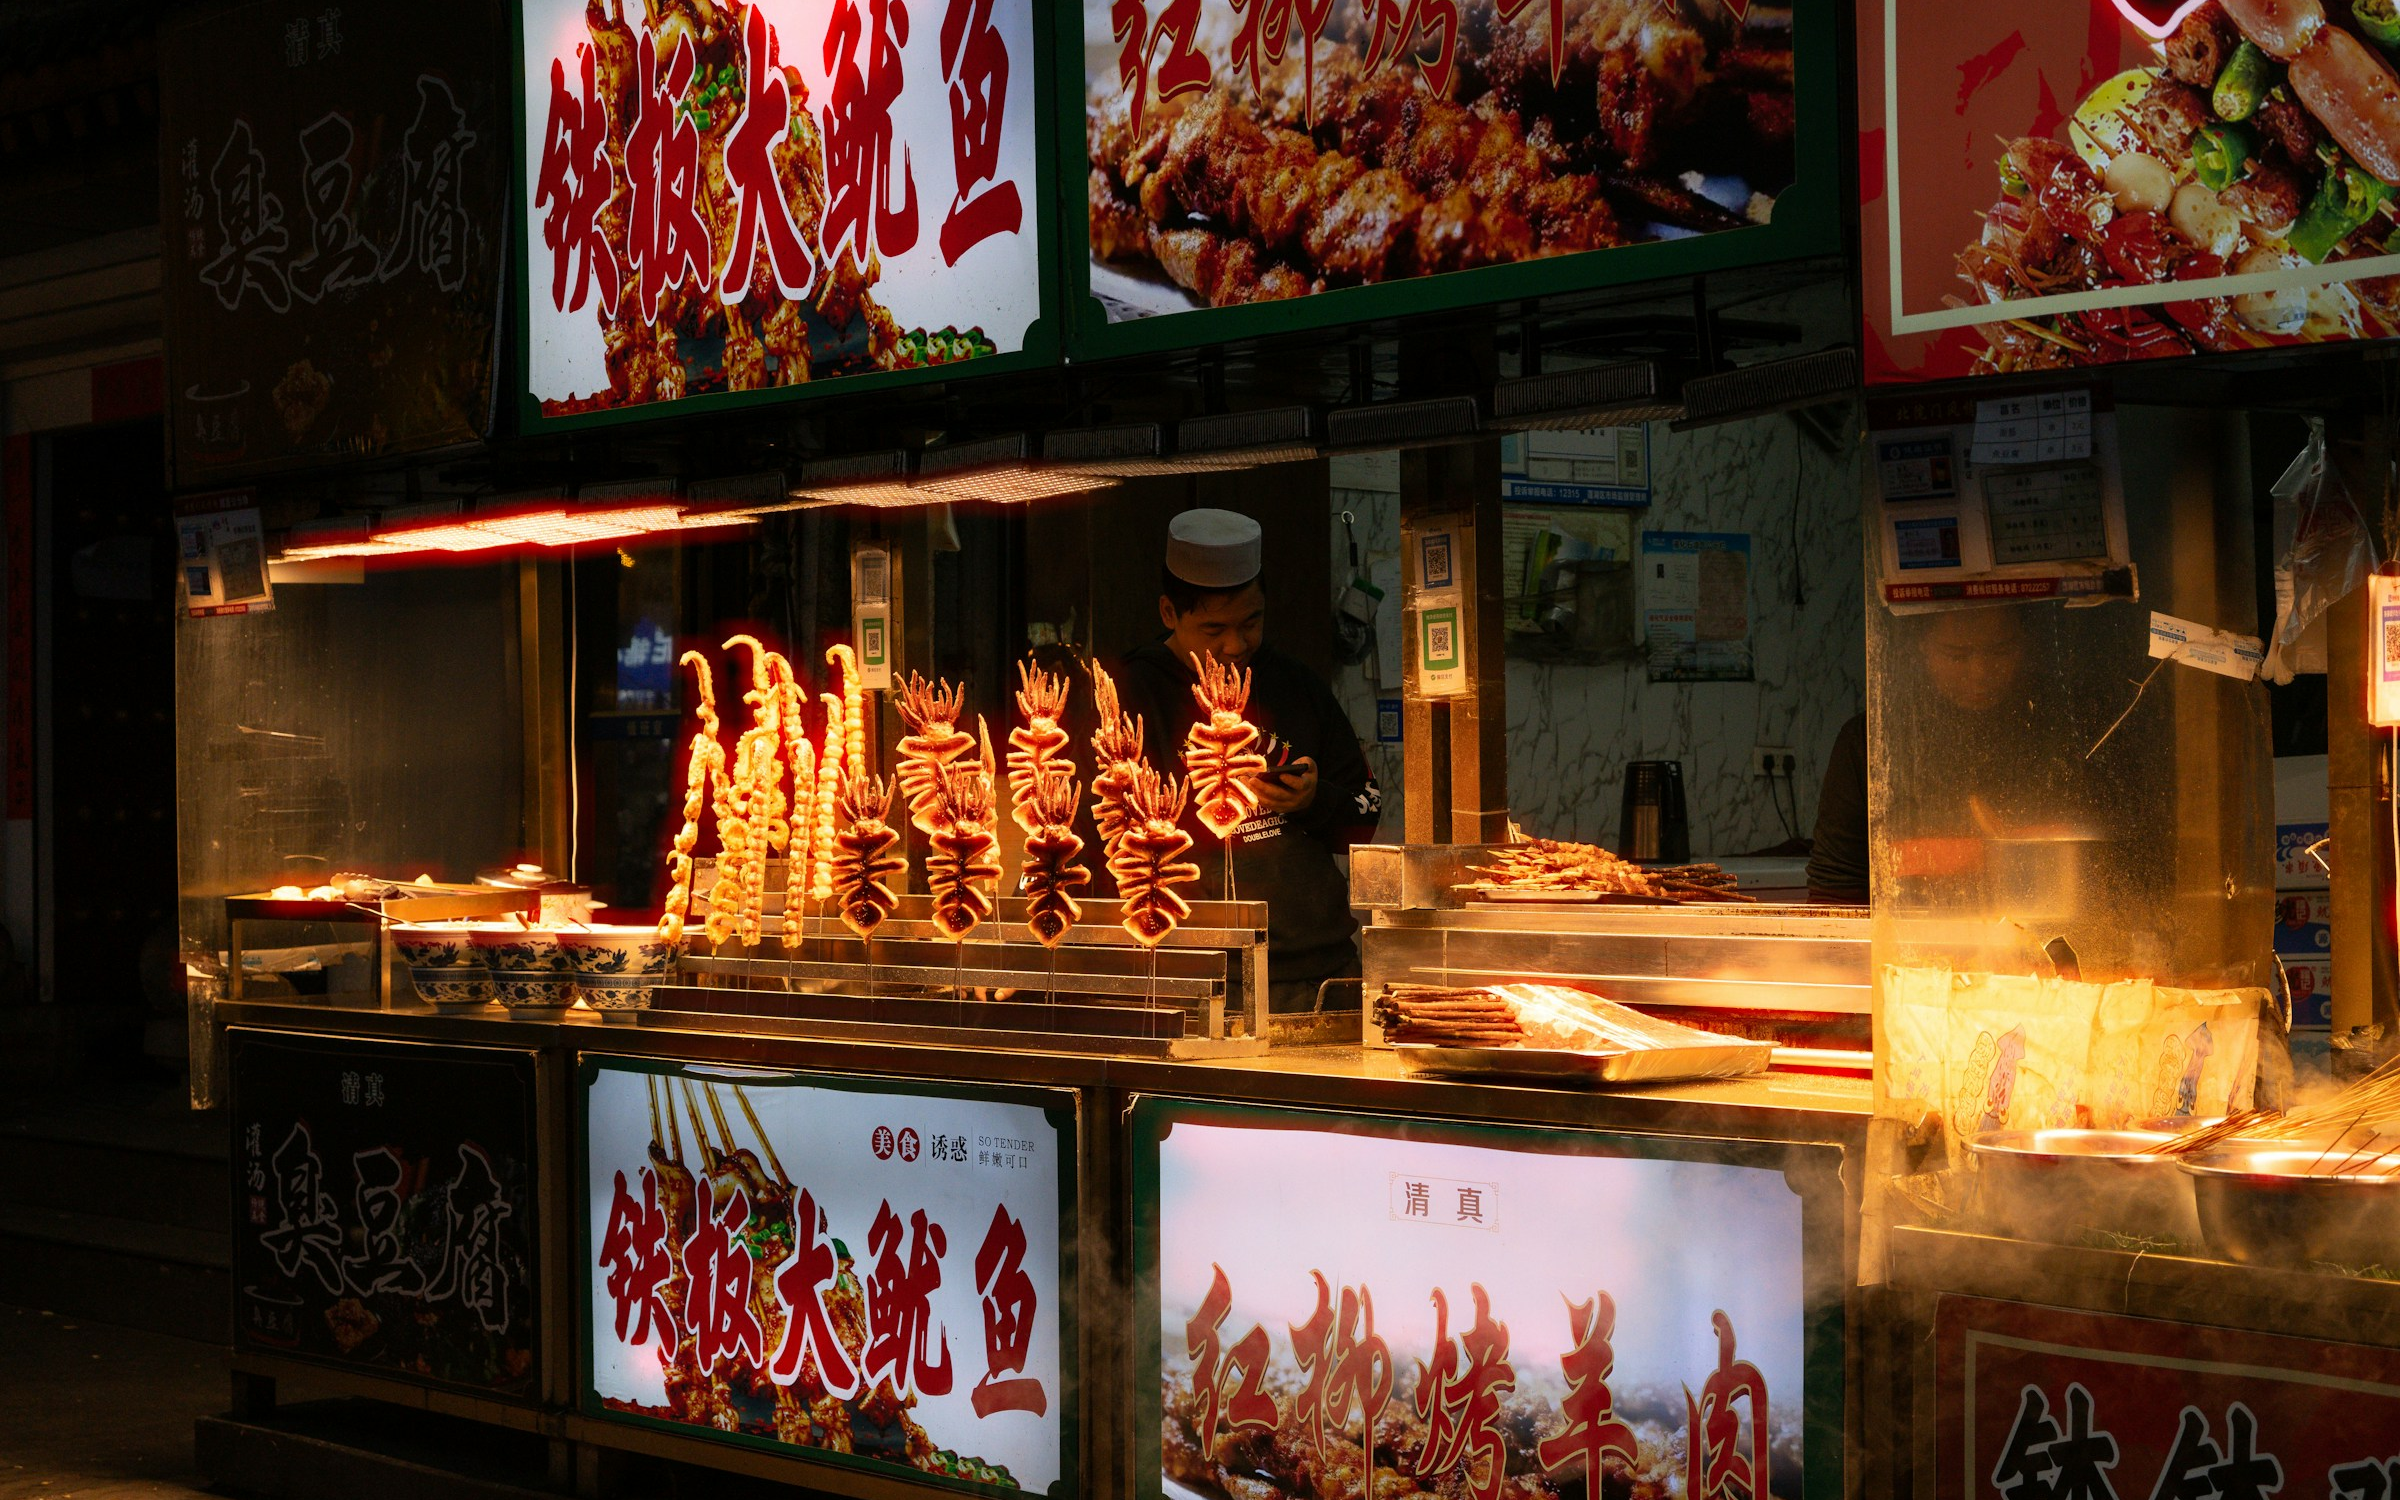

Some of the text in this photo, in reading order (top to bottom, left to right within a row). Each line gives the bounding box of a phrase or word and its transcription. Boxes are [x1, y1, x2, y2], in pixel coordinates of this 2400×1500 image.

[198, 72, 478, 315] 臭豆腐
[1559, 489, 1580, 499] 12315
[1242, 828, 1283, 843] DOUBLELOVE
[341, 1070, 385, 1108] 清真
[874, 1127, 919, 1160] 美食
[930, 1133, 968, 1163] 诱惑
[978, 1135, 1035, 1153] SO TENDER
[978, 1149, 1030, 1170] 鲜嫩可口
[1404, 1180, 1485, 1225] 清真
[259, 1120, 512, 1335] 臭豆腐
[599, 1171, 1047, 1418] 铁板大鱿鱼
[1186, 1260, 1769, 1500] 红柳烤羊肉
